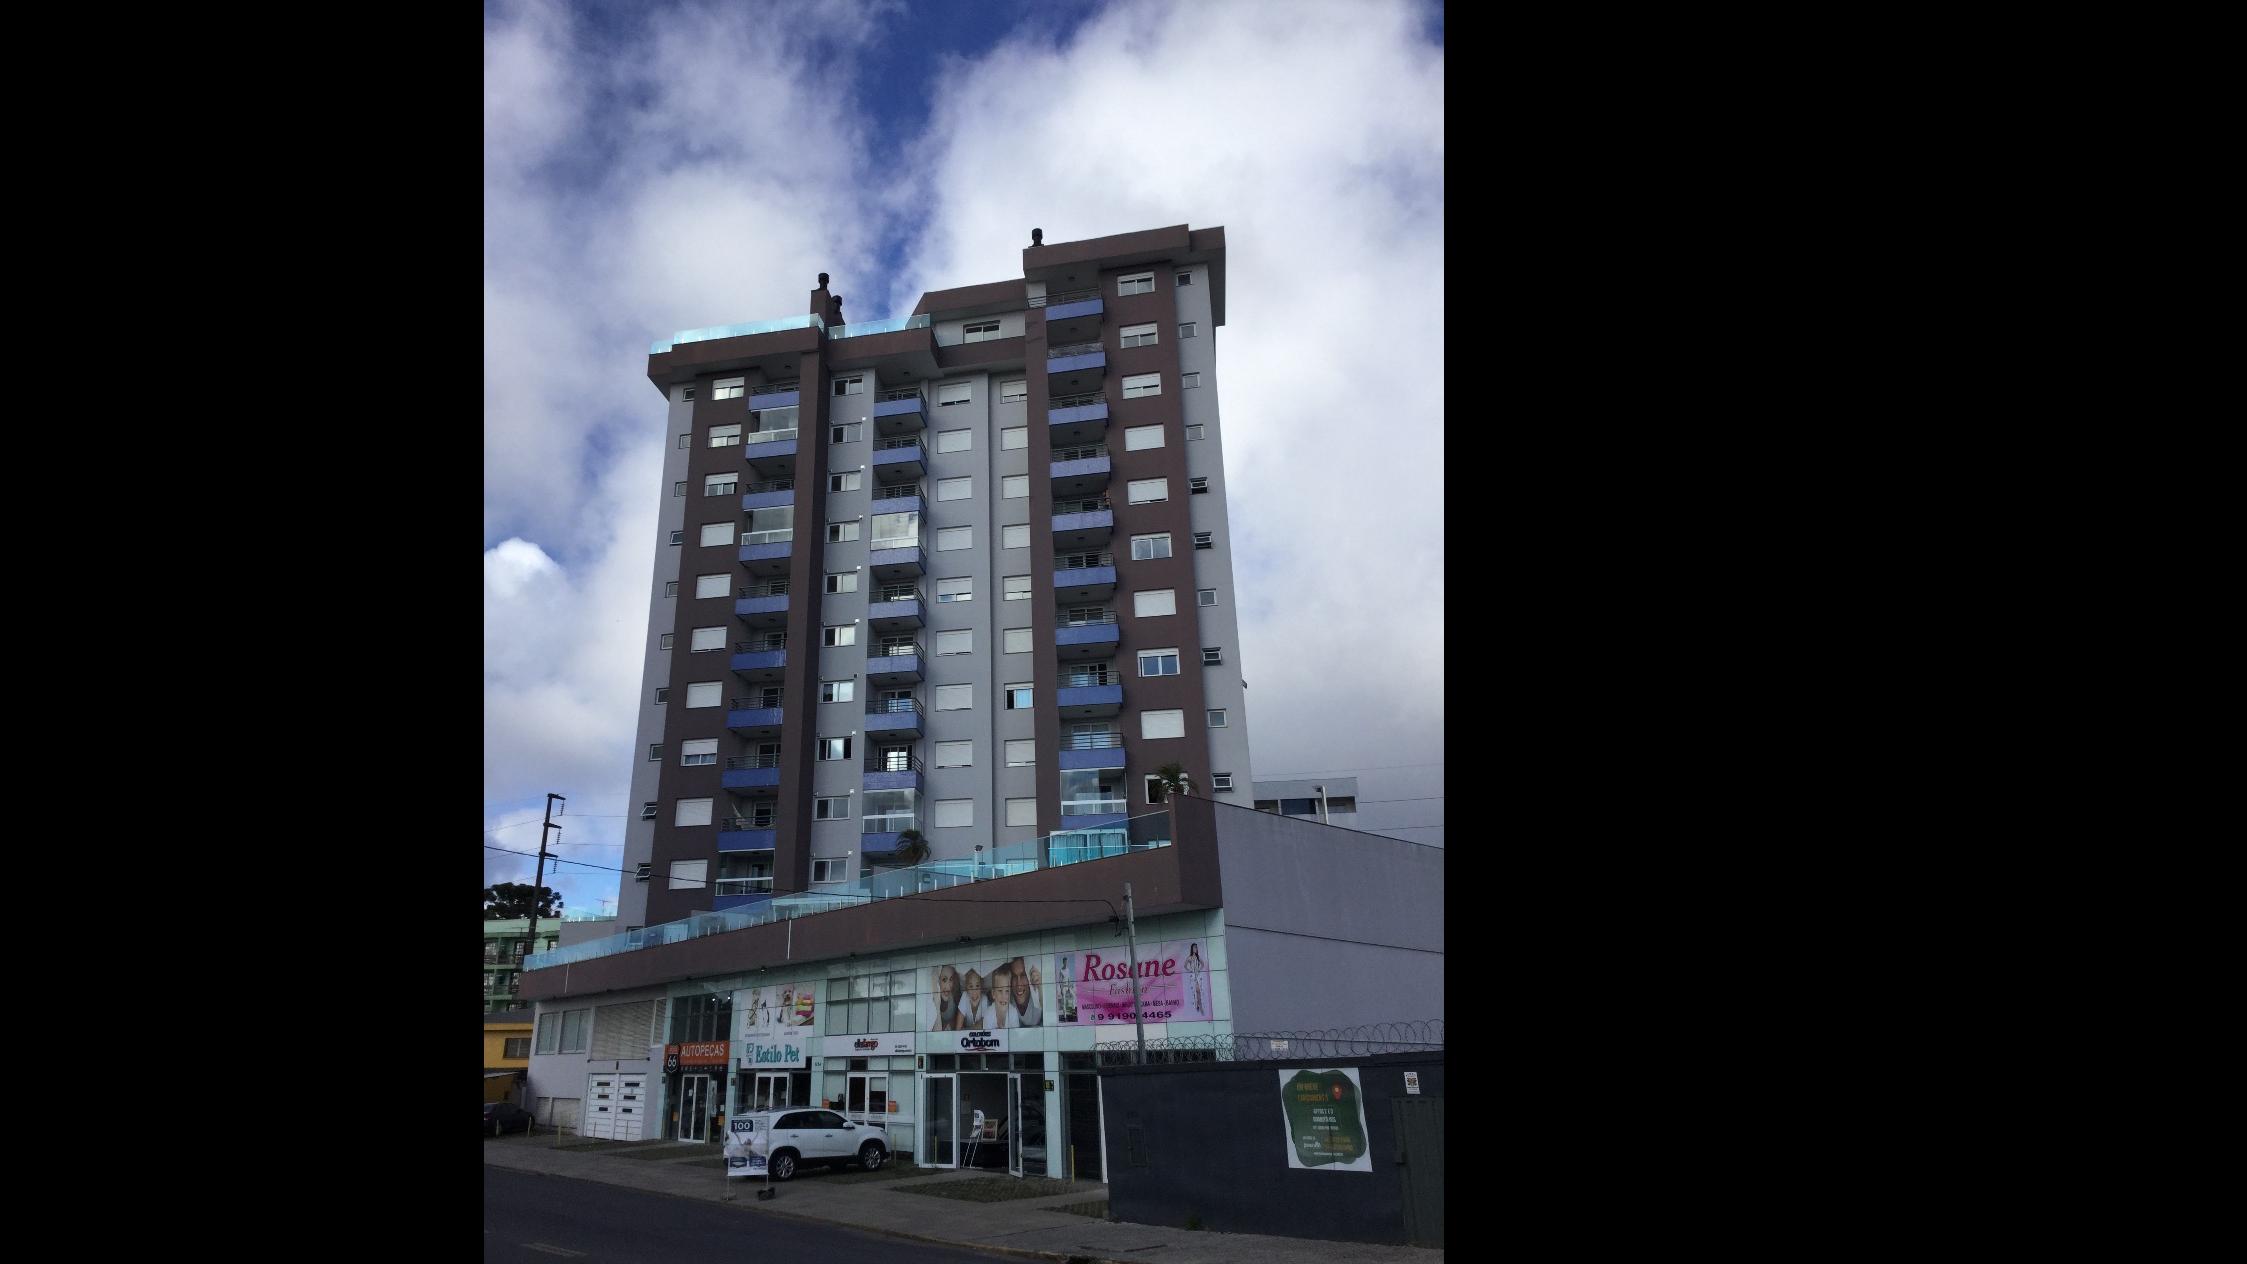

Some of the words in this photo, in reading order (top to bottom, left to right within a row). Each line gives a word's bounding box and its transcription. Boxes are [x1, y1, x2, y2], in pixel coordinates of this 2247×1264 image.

[1109, 982, 1149, 995] Fashn
[961, 1037, 1000, 1048] Ortobom
[755, 1044, 782, 1064] Estilo
[784, 1043, 800, 1063] Pet
[667, 1054, 677, 1067] 66
[734, 1122, 750, 1130] 100
